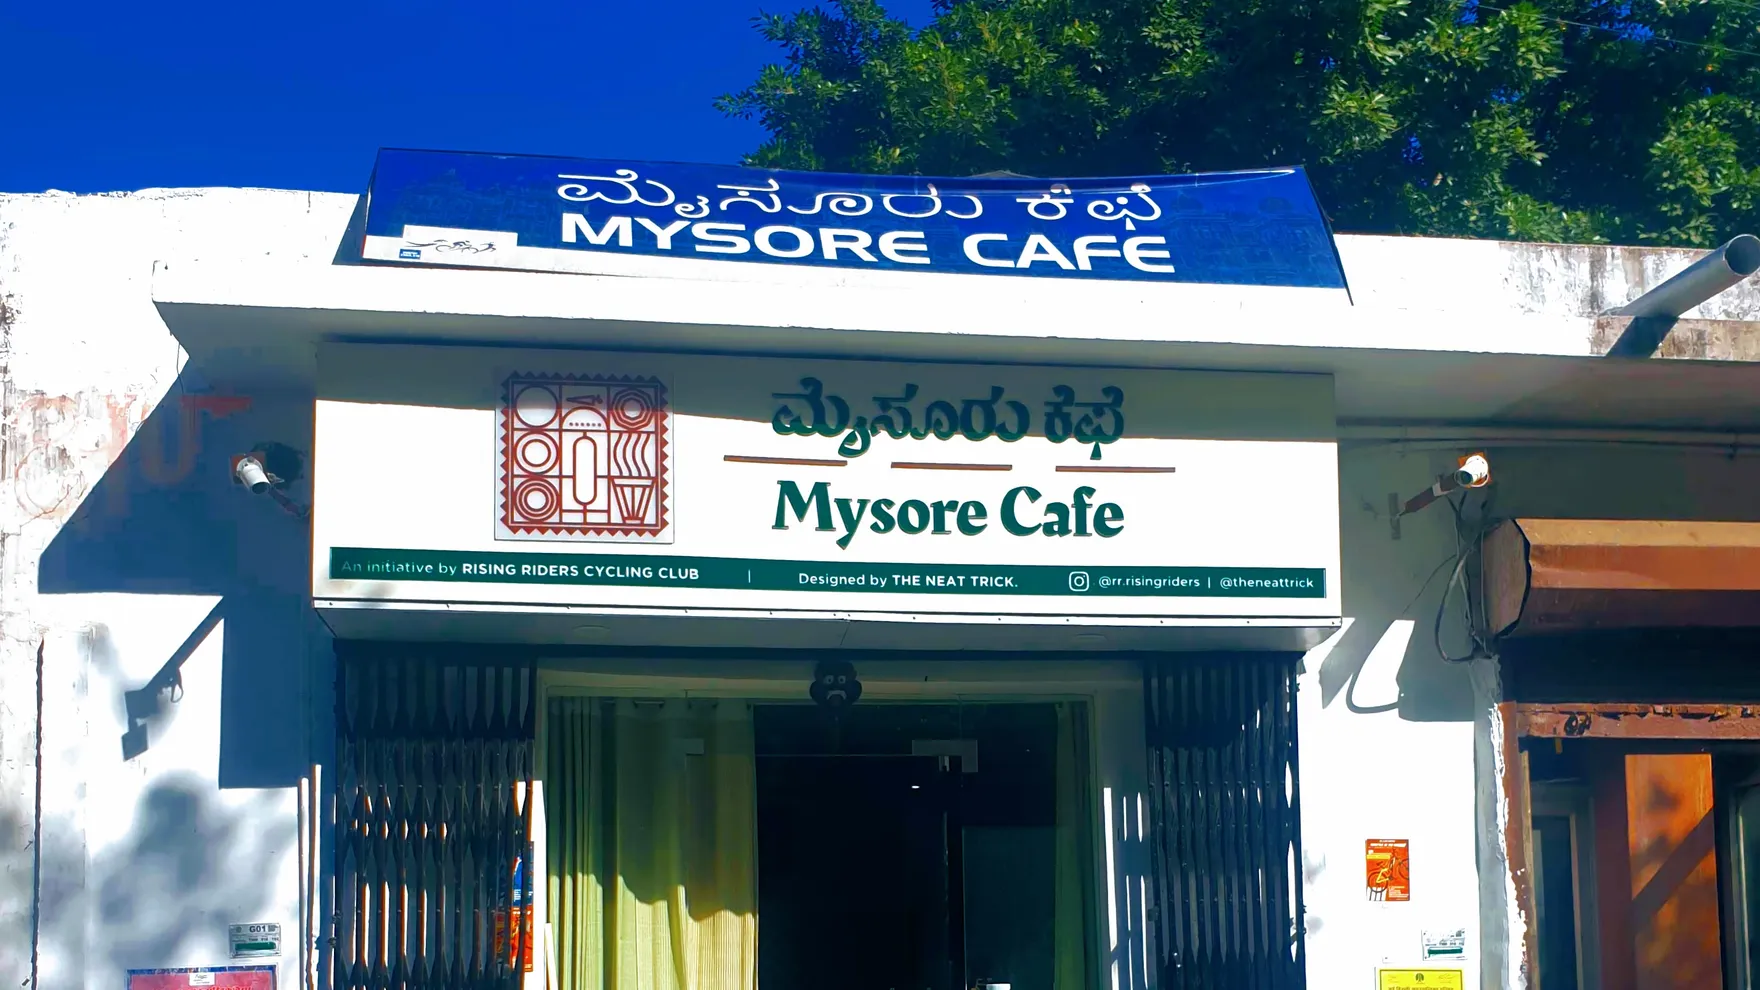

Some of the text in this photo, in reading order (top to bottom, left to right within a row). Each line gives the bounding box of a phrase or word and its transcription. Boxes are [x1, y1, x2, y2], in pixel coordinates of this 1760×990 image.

[557, 168, 984, 220] ಮೈಸೂರು
[561, 212, 1176, 274] MYSORE CAFE
[772, 377, 1125, 461] ಮೈಸೂರು ಕೆಫೆ
[772, 480, 1125, 550] Mysore Cafe
[341, 559, 700, 581] An initiative by RISING RIDERS CYCLING CLUB
[798, 572, 1019, 588] Designed by THE NEAT TRICK.
[1098, 575, 1201, 590] @rr.risingriders
[1219, 576, 1315, 590] @theneattrick
[249, 925, 266, 933] G01
